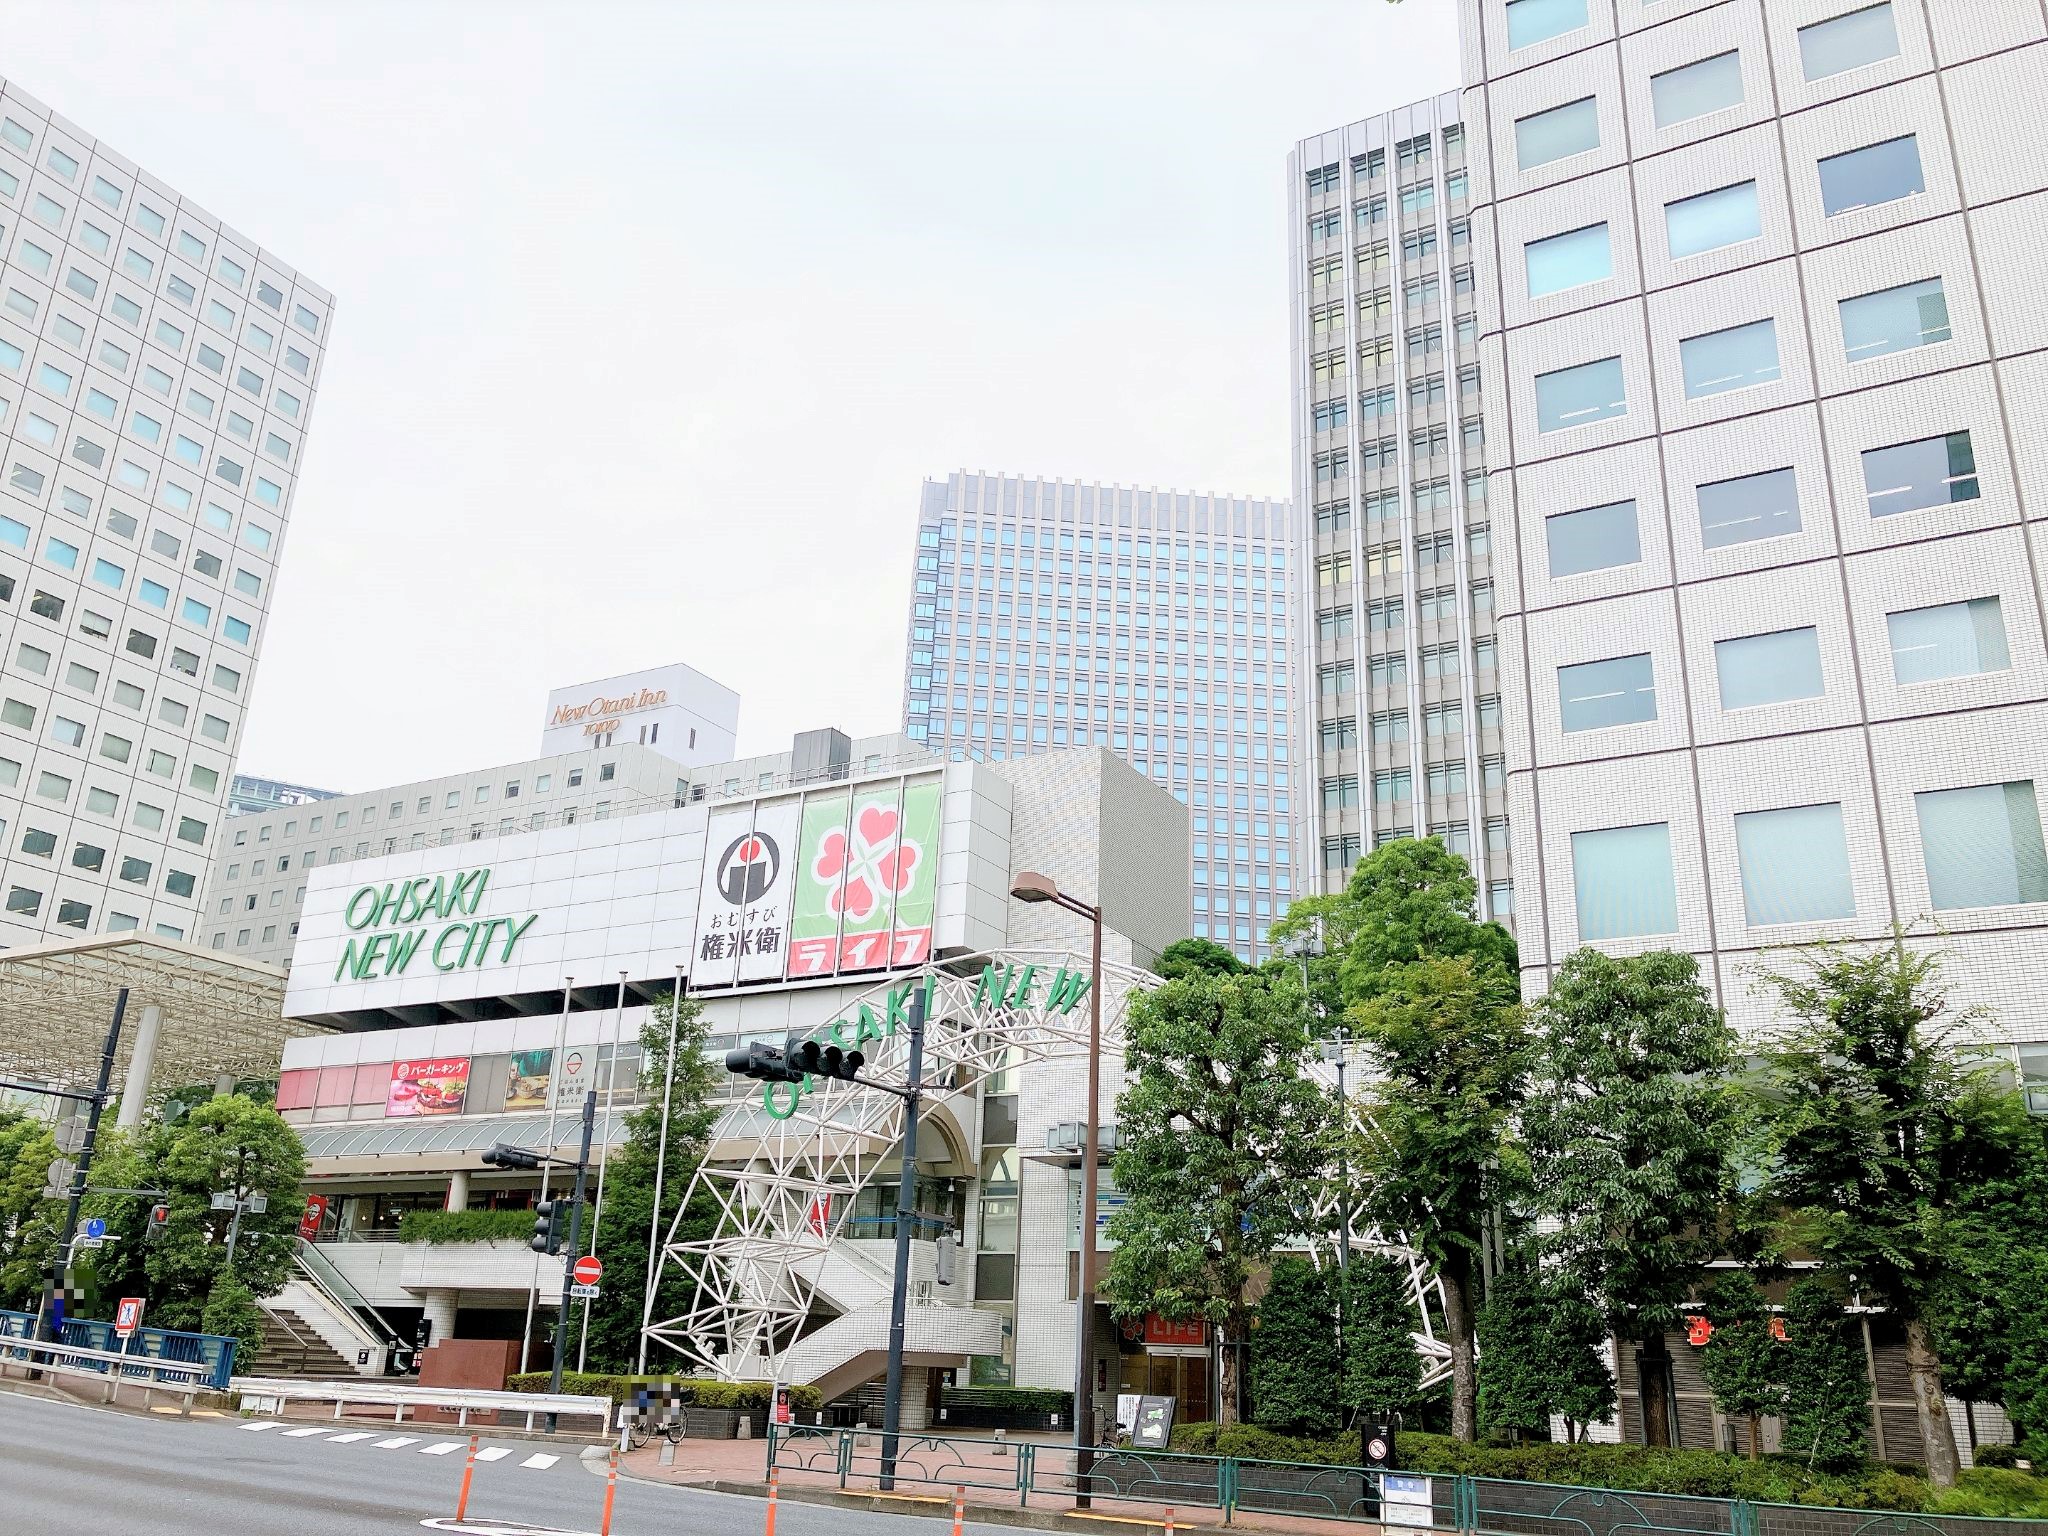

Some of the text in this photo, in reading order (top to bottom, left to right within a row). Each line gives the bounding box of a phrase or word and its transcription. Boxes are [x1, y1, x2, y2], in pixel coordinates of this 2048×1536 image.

[550, 688, 668, 725] New Otani Inn
[583, 718, 621, 737] TOKYO
[345, 868, 491, 930] OHSAKI
[710, 905, 777, 928] おむすび
[334, 914, 538, 982] NEW CITY
[700, 926, 782, 961] 権米衛
[799, 934, 923, 972] ライフ
[764, 964, 1092, 1120] OSAKI NEW
[411, 1061, 466, 1075] バーガーキング
[1153, 1320, 1199, 1336] LIFE
